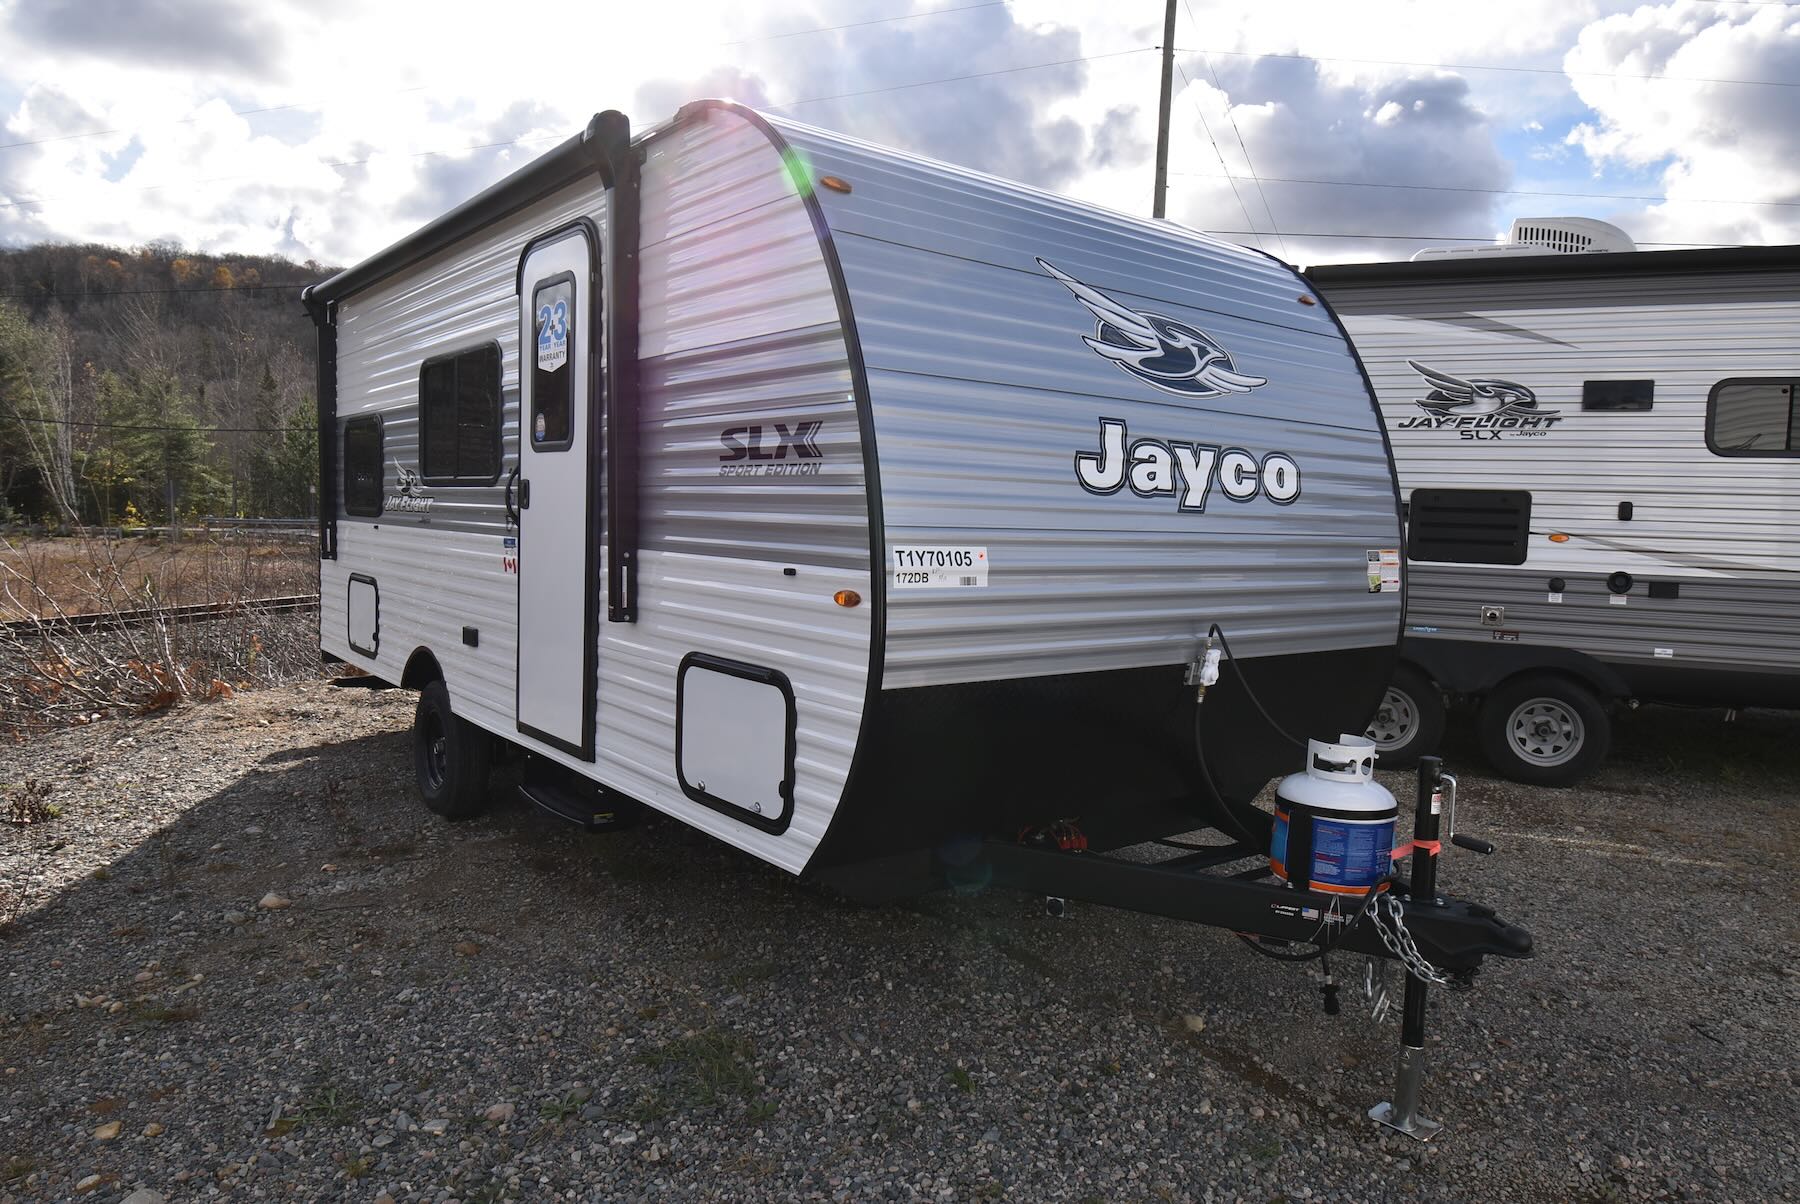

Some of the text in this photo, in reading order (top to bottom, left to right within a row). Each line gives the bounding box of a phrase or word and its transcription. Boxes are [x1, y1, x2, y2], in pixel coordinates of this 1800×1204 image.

[539, 351, 566, 363] WARRANTY
[1398, 415, 1562, 429] JAY FLIGHT
[719, 420, 824, 462] SLX
[1460, 430, 1503, 440] SLX
[718, 462, 823, 477] SPORT EDITION
[1074, 416, 1302, 514] Jayco
[385, 496, 435, 513] JAY FLIGHT
[895, 550, 973, 567] T1Y70105
[895, 572, 929, 584] 172DB
